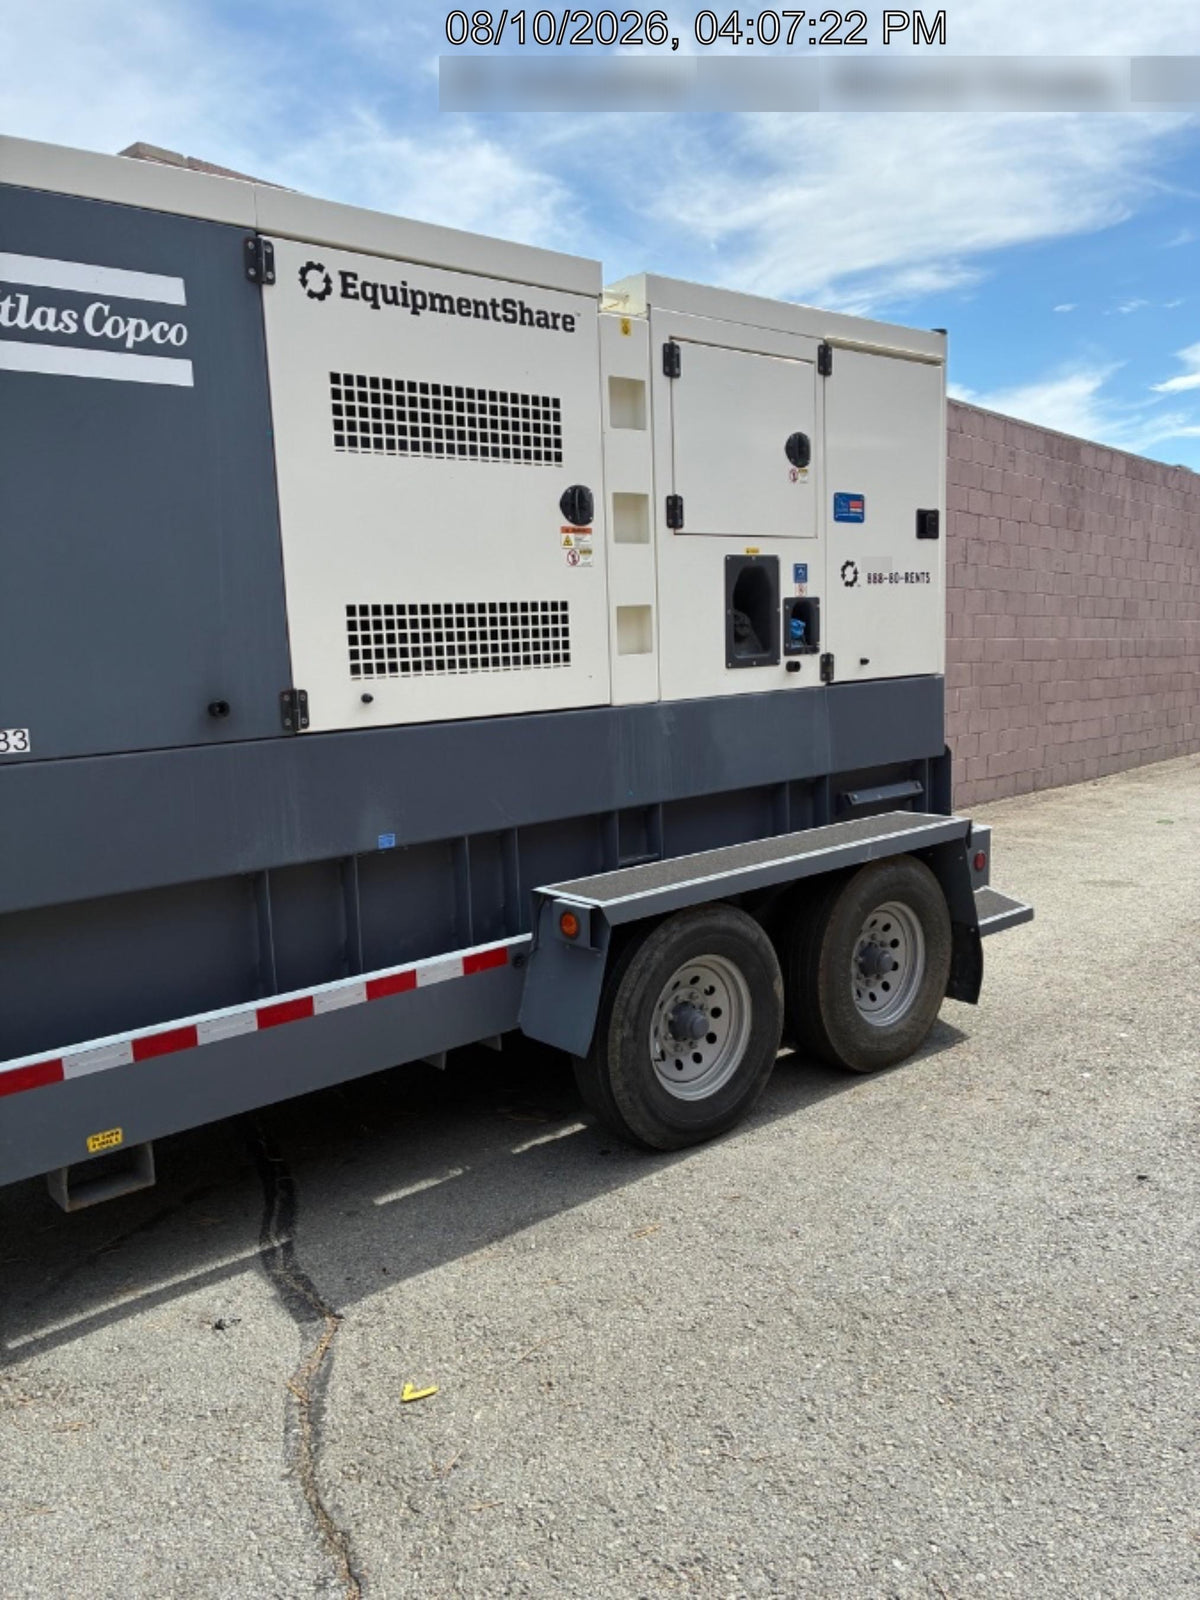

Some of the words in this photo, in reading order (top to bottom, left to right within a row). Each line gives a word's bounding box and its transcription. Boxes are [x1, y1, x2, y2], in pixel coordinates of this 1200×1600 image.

[0, 288, 79, 334] tlas
[83, 301, 188, 349] Copco
[338, 269, 576, 333] EquipmentShare
